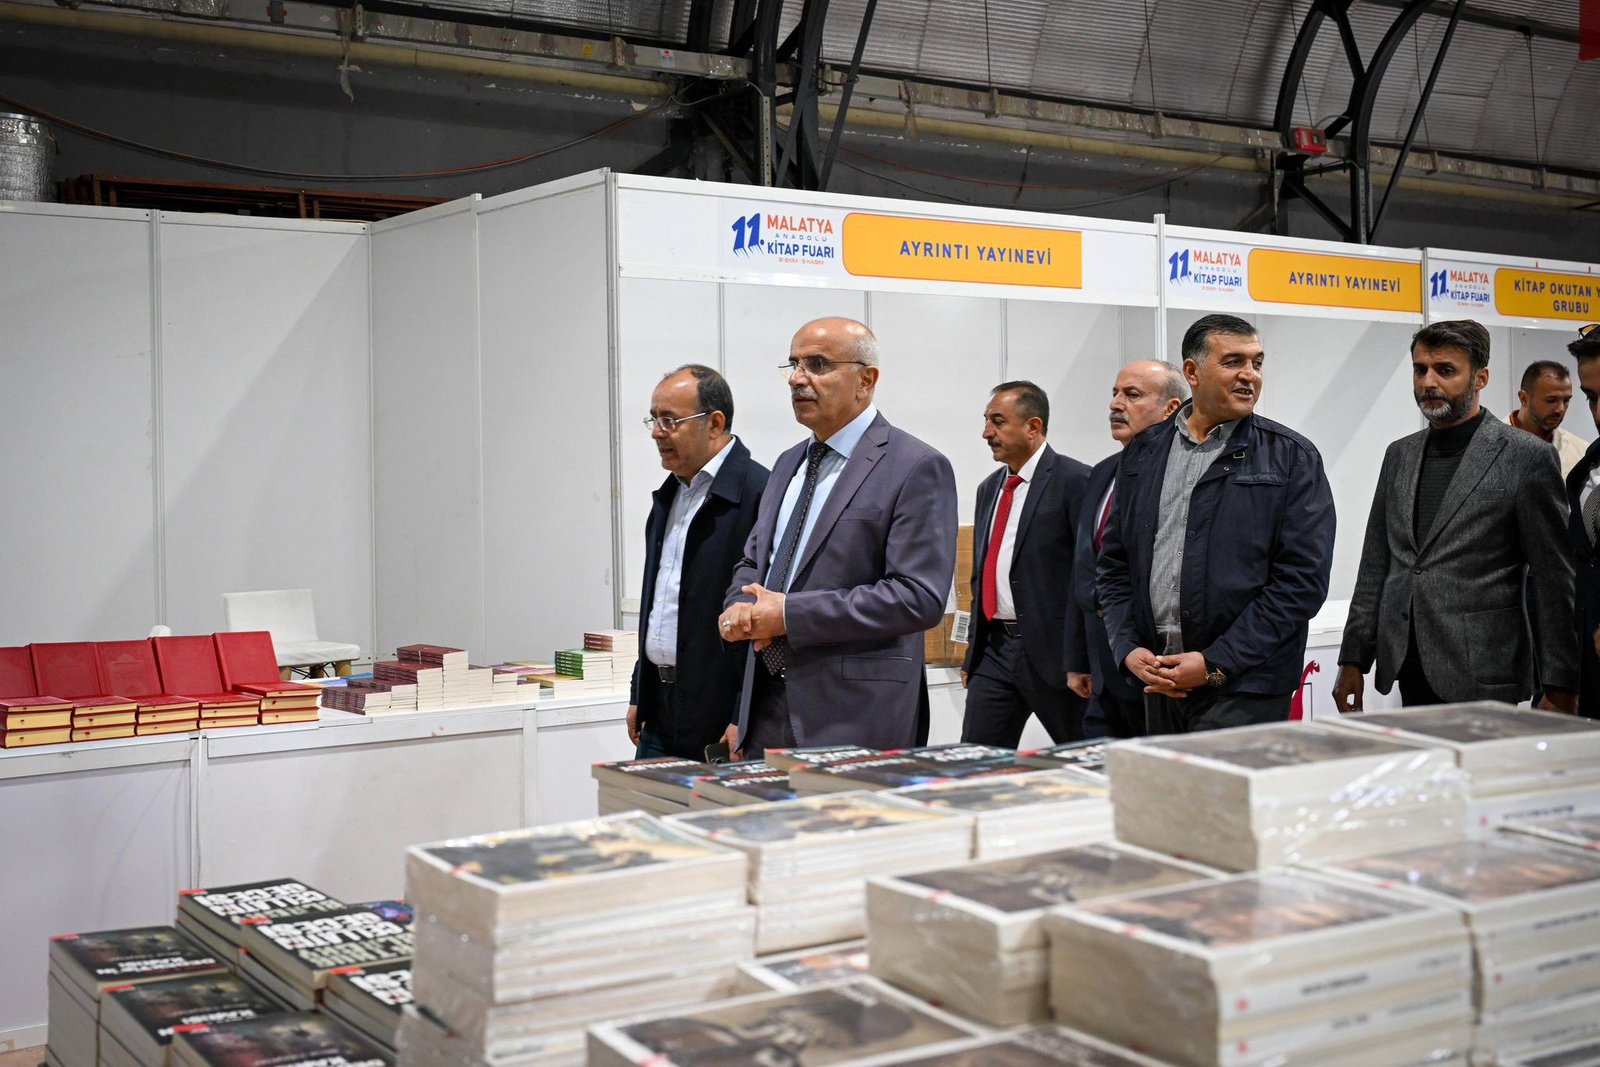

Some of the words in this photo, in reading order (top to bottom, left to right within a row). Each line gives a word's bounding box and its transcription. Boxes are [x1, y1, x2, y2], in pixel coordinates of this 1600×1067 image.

[767, 214, 833, 234] MALATYA
[775, 233, 827, 242] ANADOLU
[768, 240, 799, 255] KİTAP
[802, 244, 834, 258] FUARI
[899, 240, 969, 260] AYRINTI
[976, 245, 1051, 265] YAYINEVİ
[1194, 250, 1241, 266] MALATYA
[1194, 272, 1216, 284] KİTAP
[1219, 275, 1242, 286] FUARI
[1289, 271, 1340, 288] AYRINTI
[1345, 275, 1400, 293] YAYINEVİ
[1450, 270, 1489, 284] MALATYA
[1514, 277, 1545, 293] KİTAP
[1550, 282, 1592, 297] OKUTAN
[1450, 289, 1469, 300] KİTAP
[1471, 292, 1490, 302] FUARI
[1553, 300, 1589, 314] GRUBU
